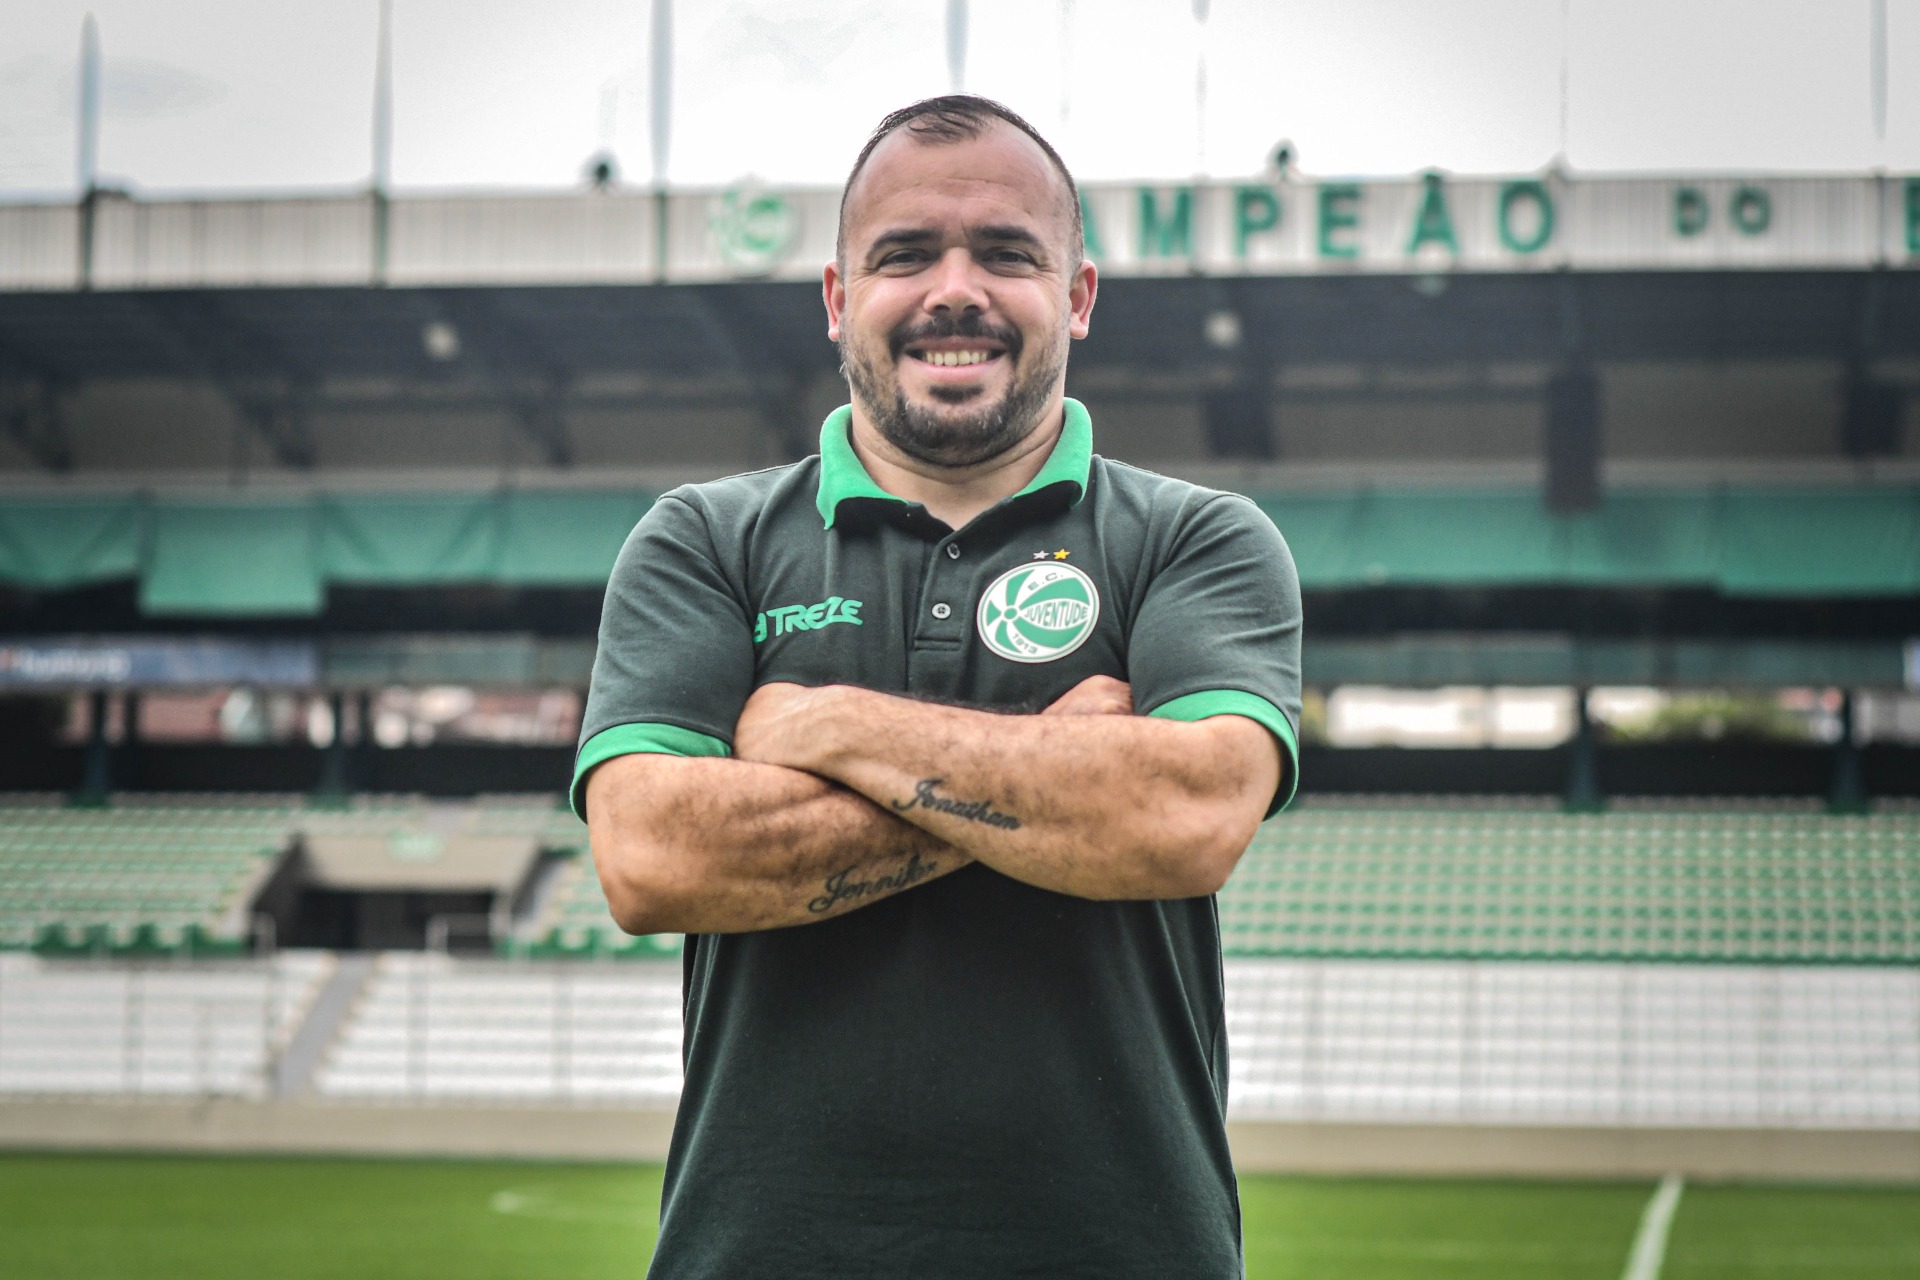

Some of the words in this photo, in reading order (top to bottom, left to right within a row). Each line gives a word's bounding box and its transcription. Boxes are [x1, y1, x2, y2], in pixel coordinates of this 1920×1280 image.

[1675, 184, 1773, 238] DO
[1024, 601, 1088, 628] JUVENTUDE
[1012, 633, 1039, 654] 1913
[893, 778, 1021, 831] Jonathan
